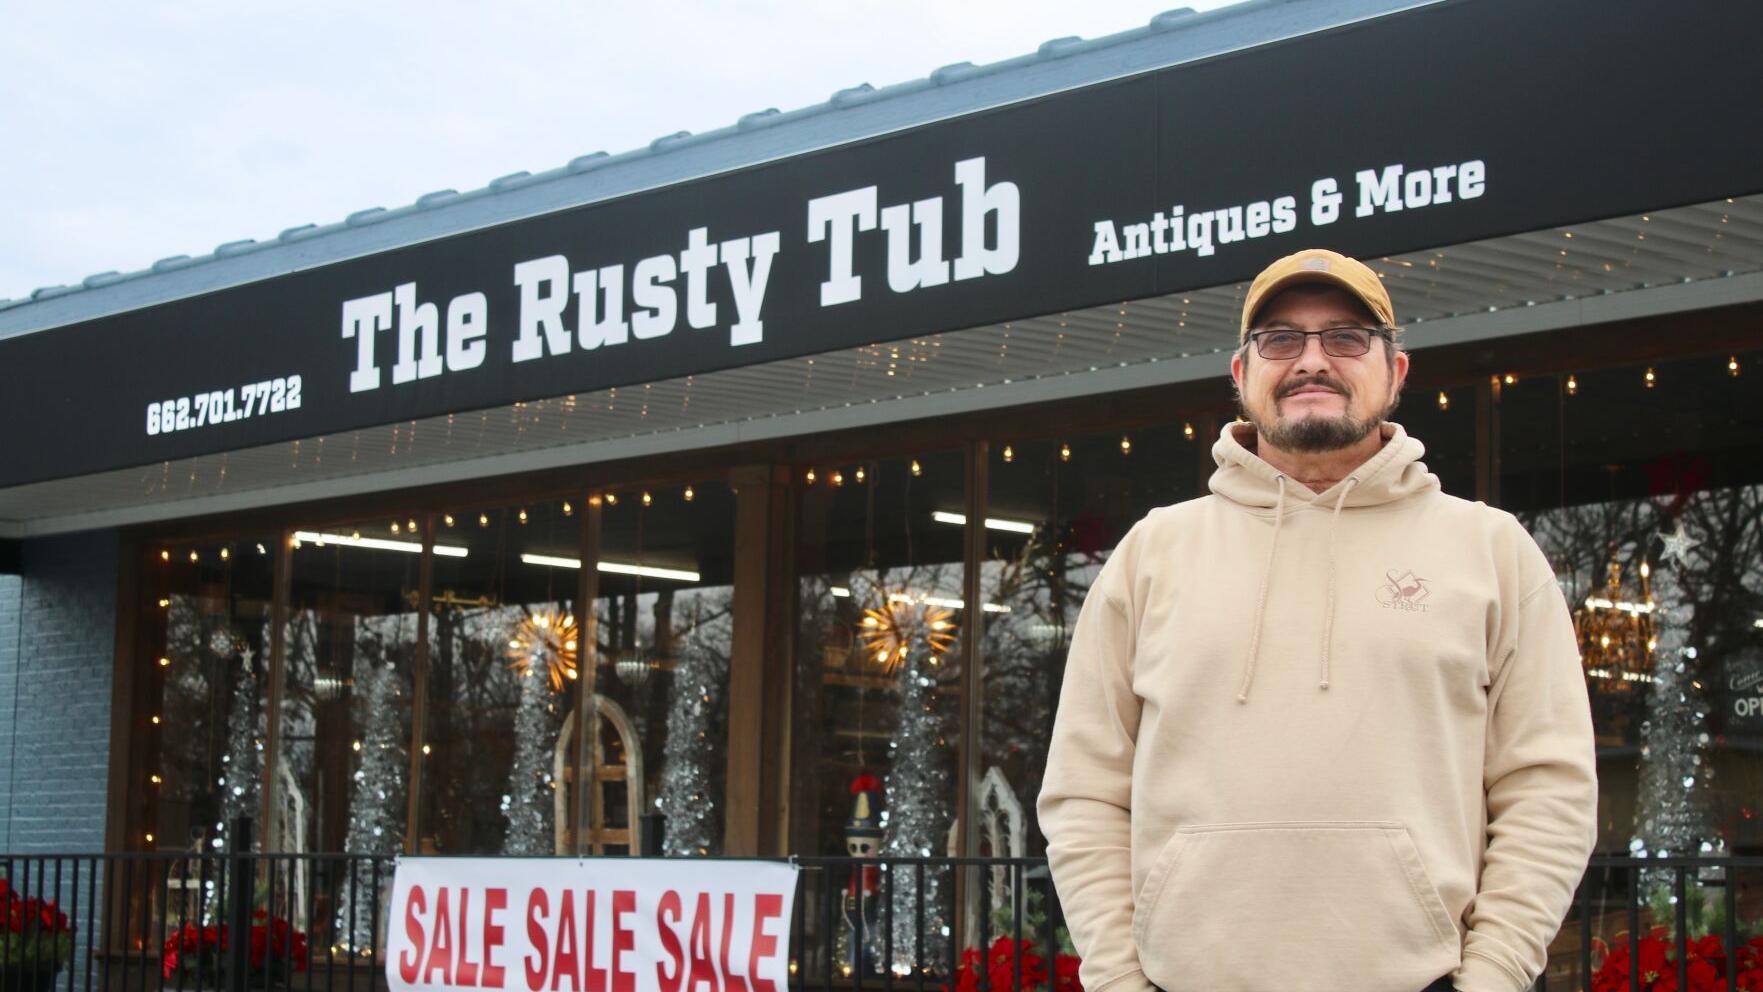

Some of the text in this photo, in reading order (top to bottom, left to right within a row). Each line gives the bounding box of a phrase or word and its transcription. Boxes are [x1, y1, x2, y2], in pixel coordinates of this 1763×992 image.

[1088, 159, 1487, 270] Antiques & More
[341, 156, 1021, 393] The Rusty Tub
[146, 374, 303, 436] 662.701.7722
[1734, 697, 1763, 716] OP
[399, 884, 784, 992] SALE SALE SALE
